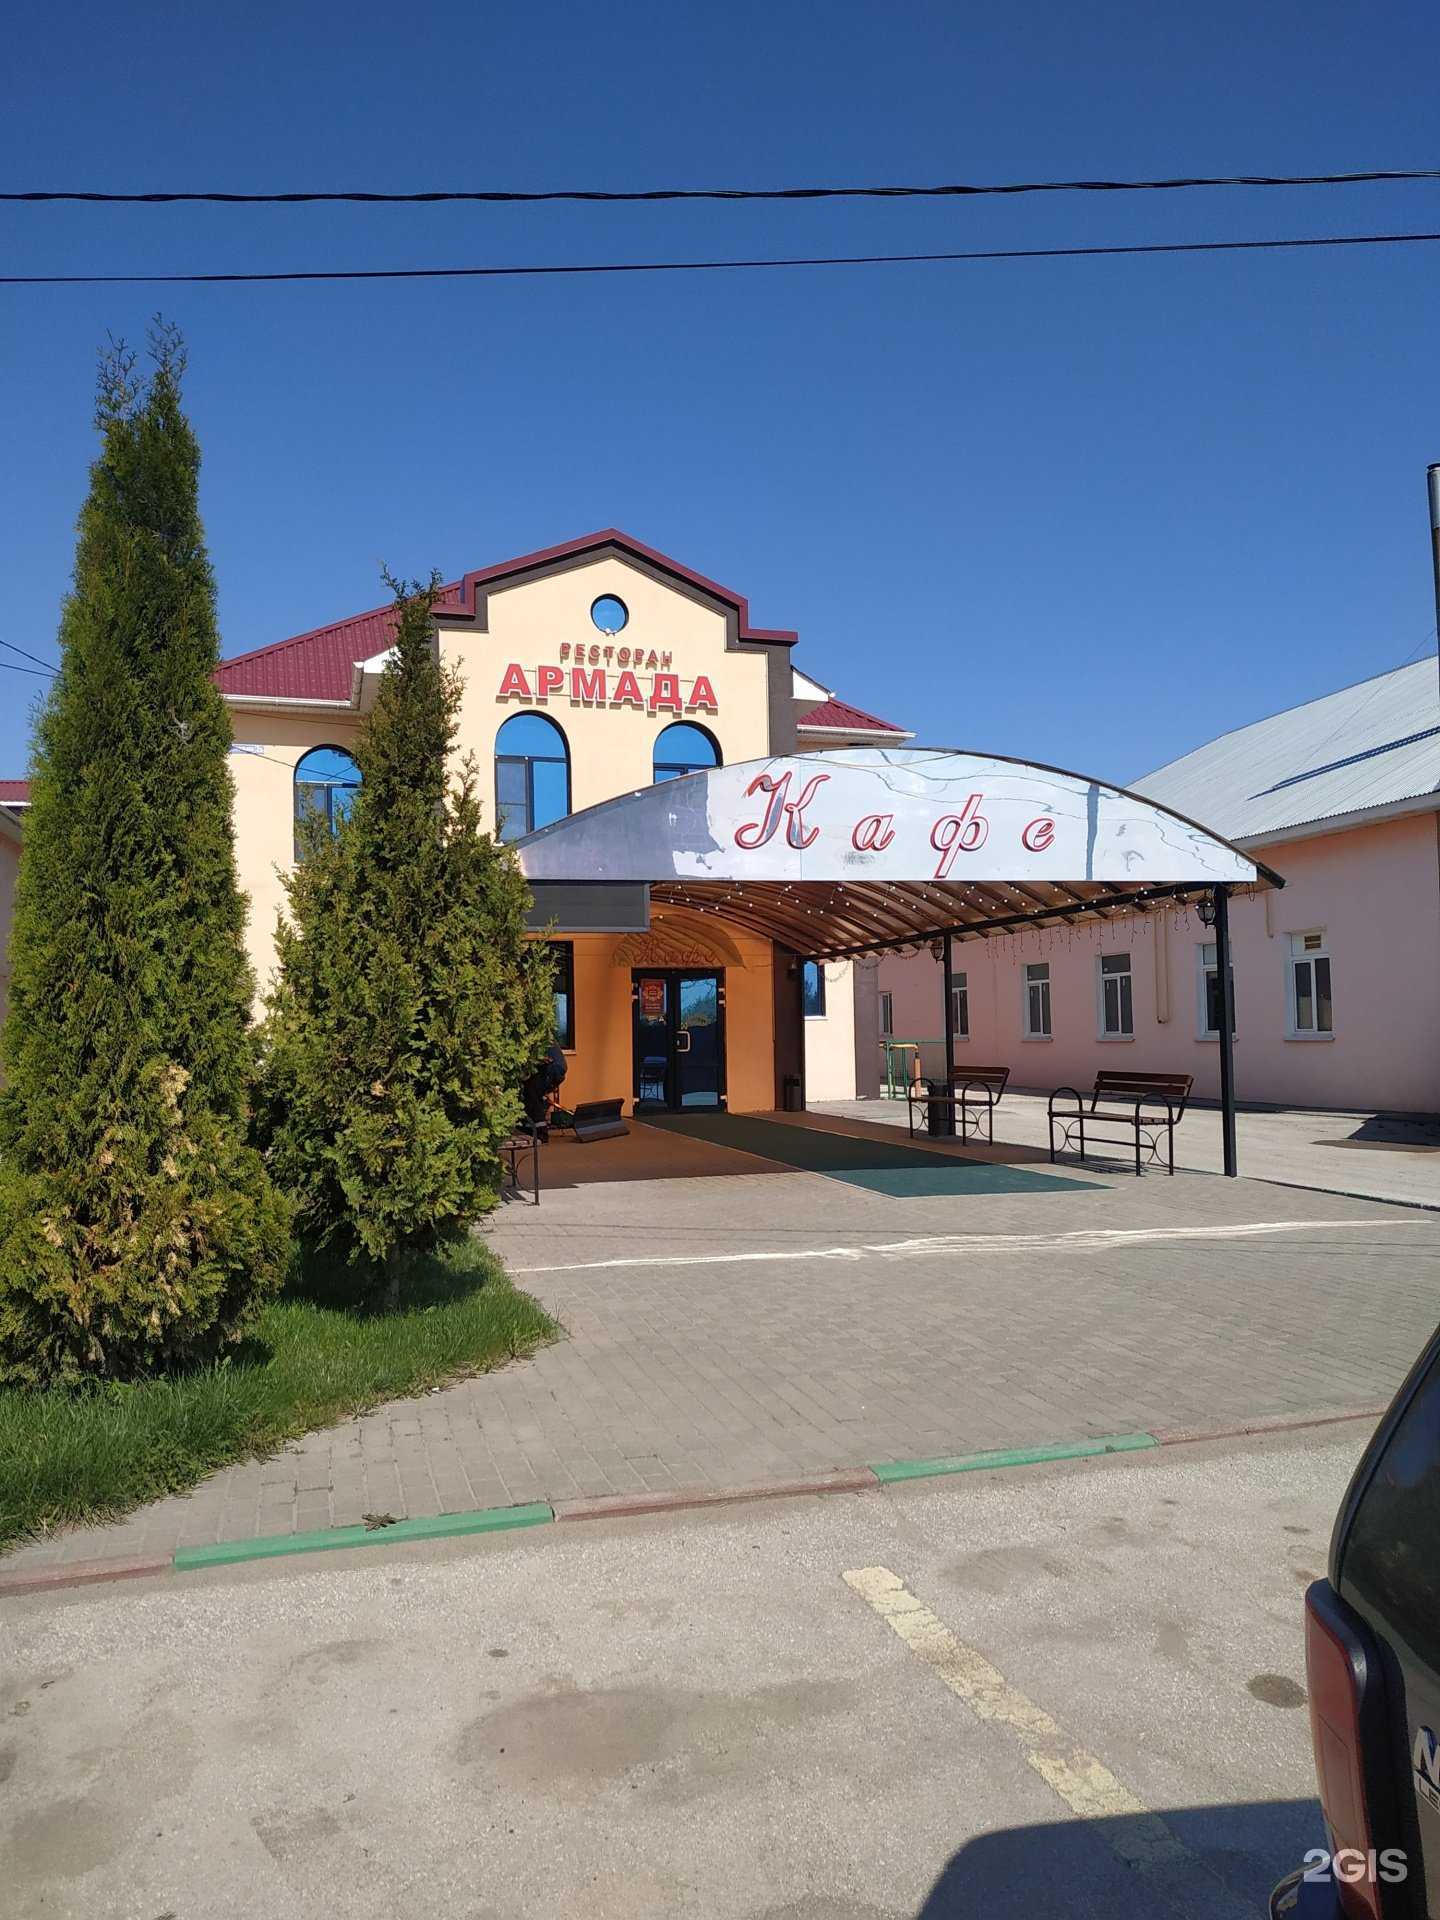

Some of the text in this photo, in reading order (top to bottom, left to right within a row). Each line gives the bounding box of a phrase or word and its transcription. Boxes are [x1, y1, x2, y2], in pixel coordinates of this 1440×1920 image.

[560, 642, 673, 667] РЕСТОРАН
[498, 663, 720, 712] АРМАДА
[734, 770, 1056, 879] Кафе
